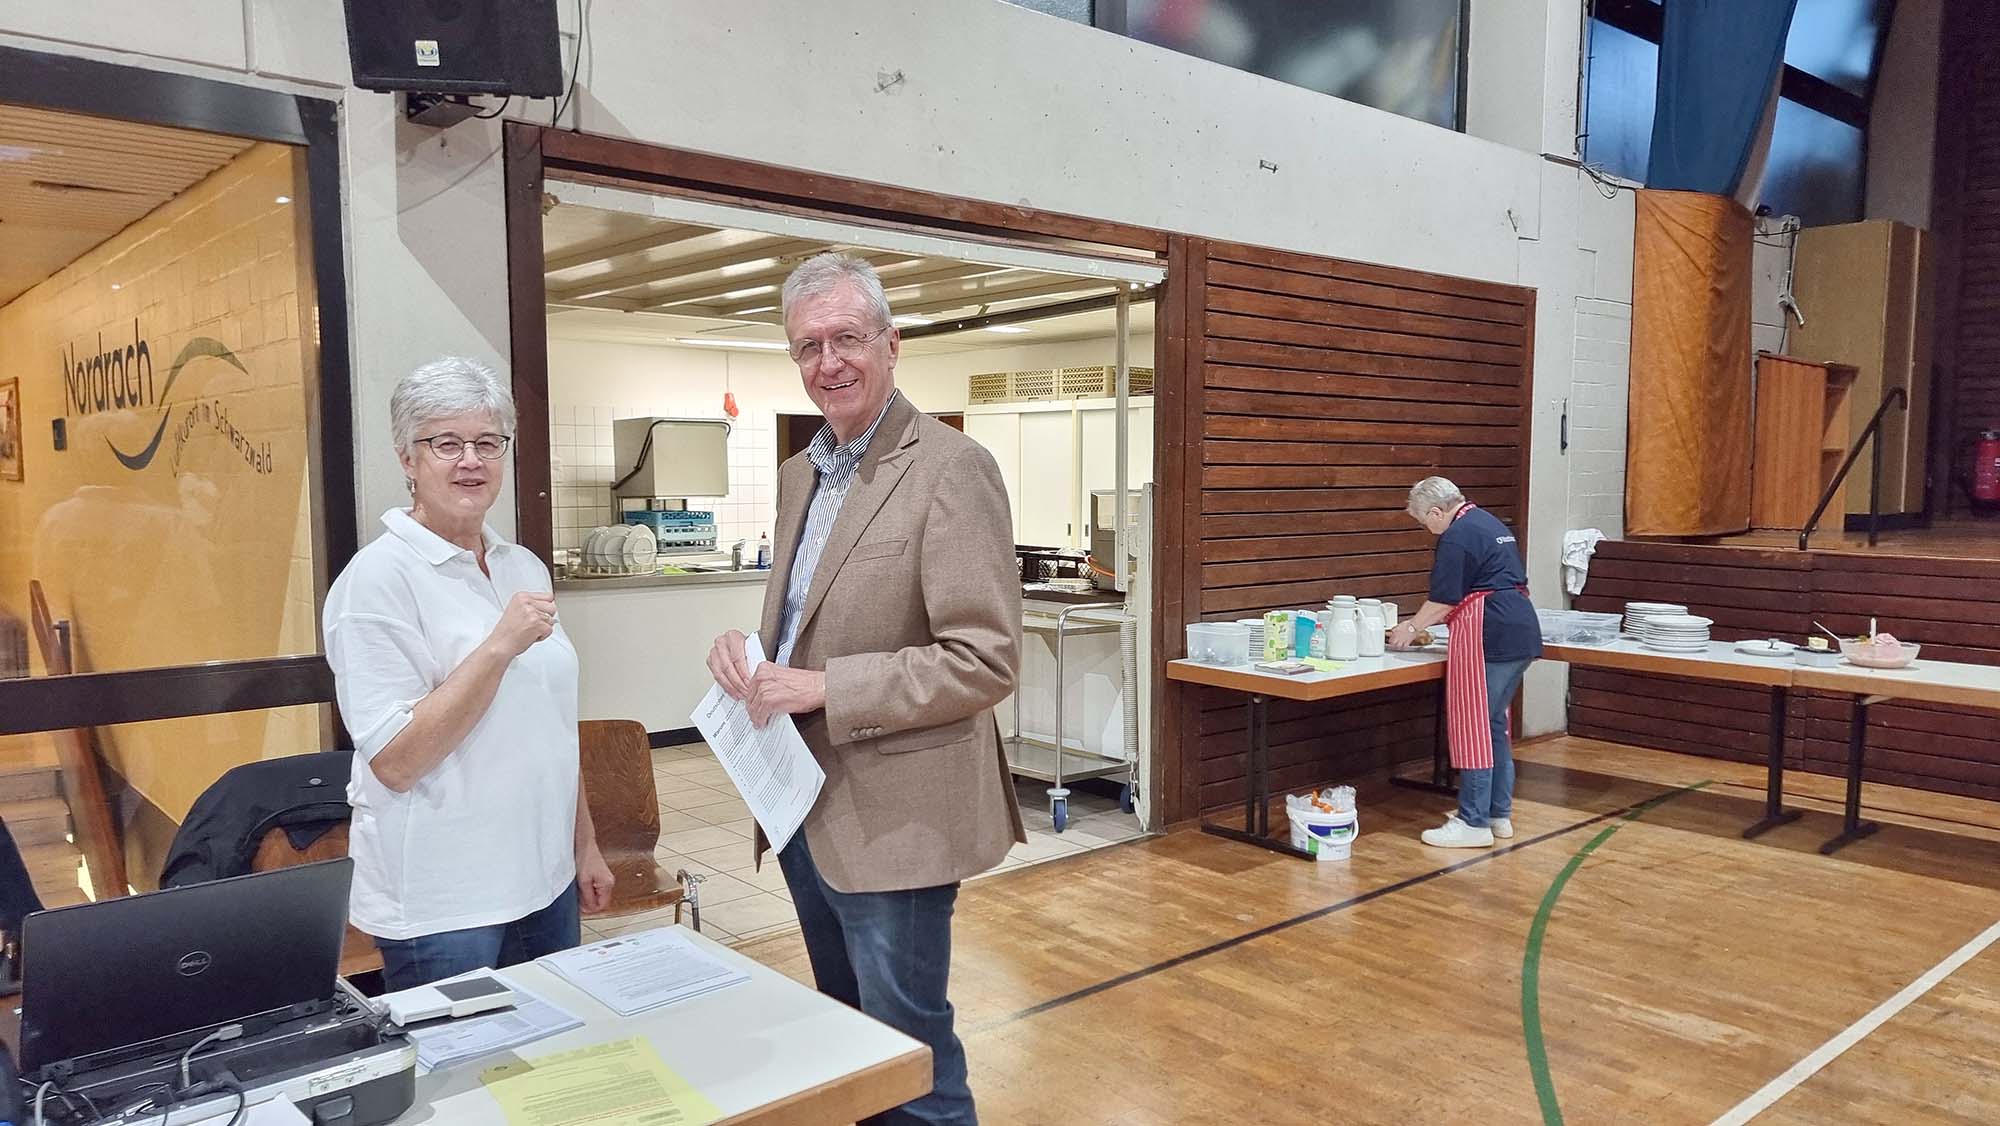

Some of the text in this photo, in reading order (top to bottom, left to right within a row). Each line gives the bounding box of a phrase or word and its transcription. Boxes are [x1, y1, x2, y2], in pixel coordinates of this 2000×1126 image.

[63, 317, 154, 417] Nordrach
[169, 397, 199, 478] Luftkurort
[214, 399, 273, 475] Schwarzwald
[181, 958, 209, 969] DELL
